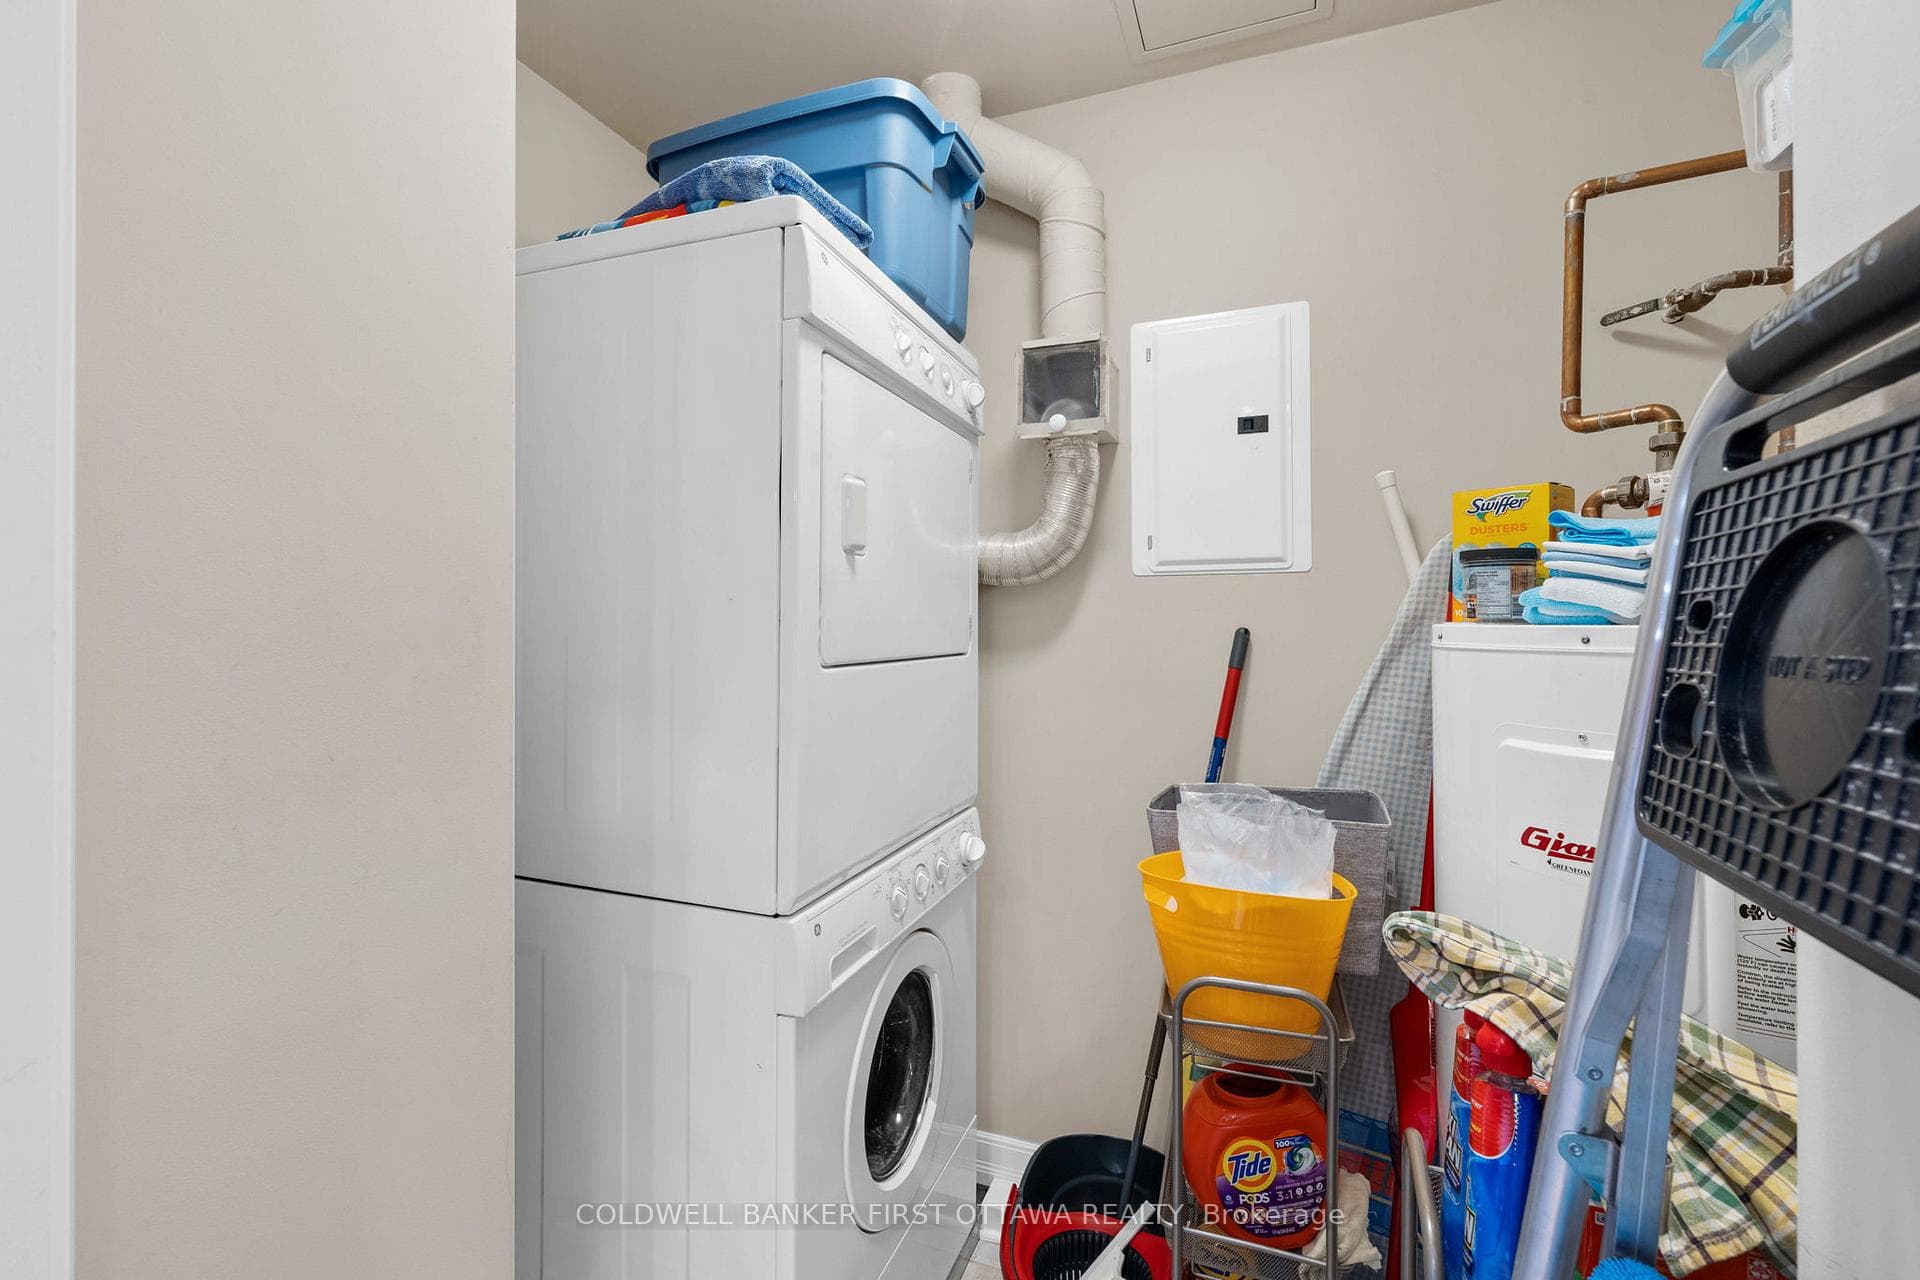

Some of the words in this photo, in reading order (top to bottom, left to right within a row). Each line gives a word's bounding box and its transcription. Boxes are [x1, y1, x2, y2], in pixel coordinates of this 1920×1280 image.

[1467, 493, 1529, 516] Swiffer
[1470, 522, 1528, 536] DUSTERS
[1228, 1150, 1272, 1185] Tide
[1239, 1192, 1270, 1205] PODS
